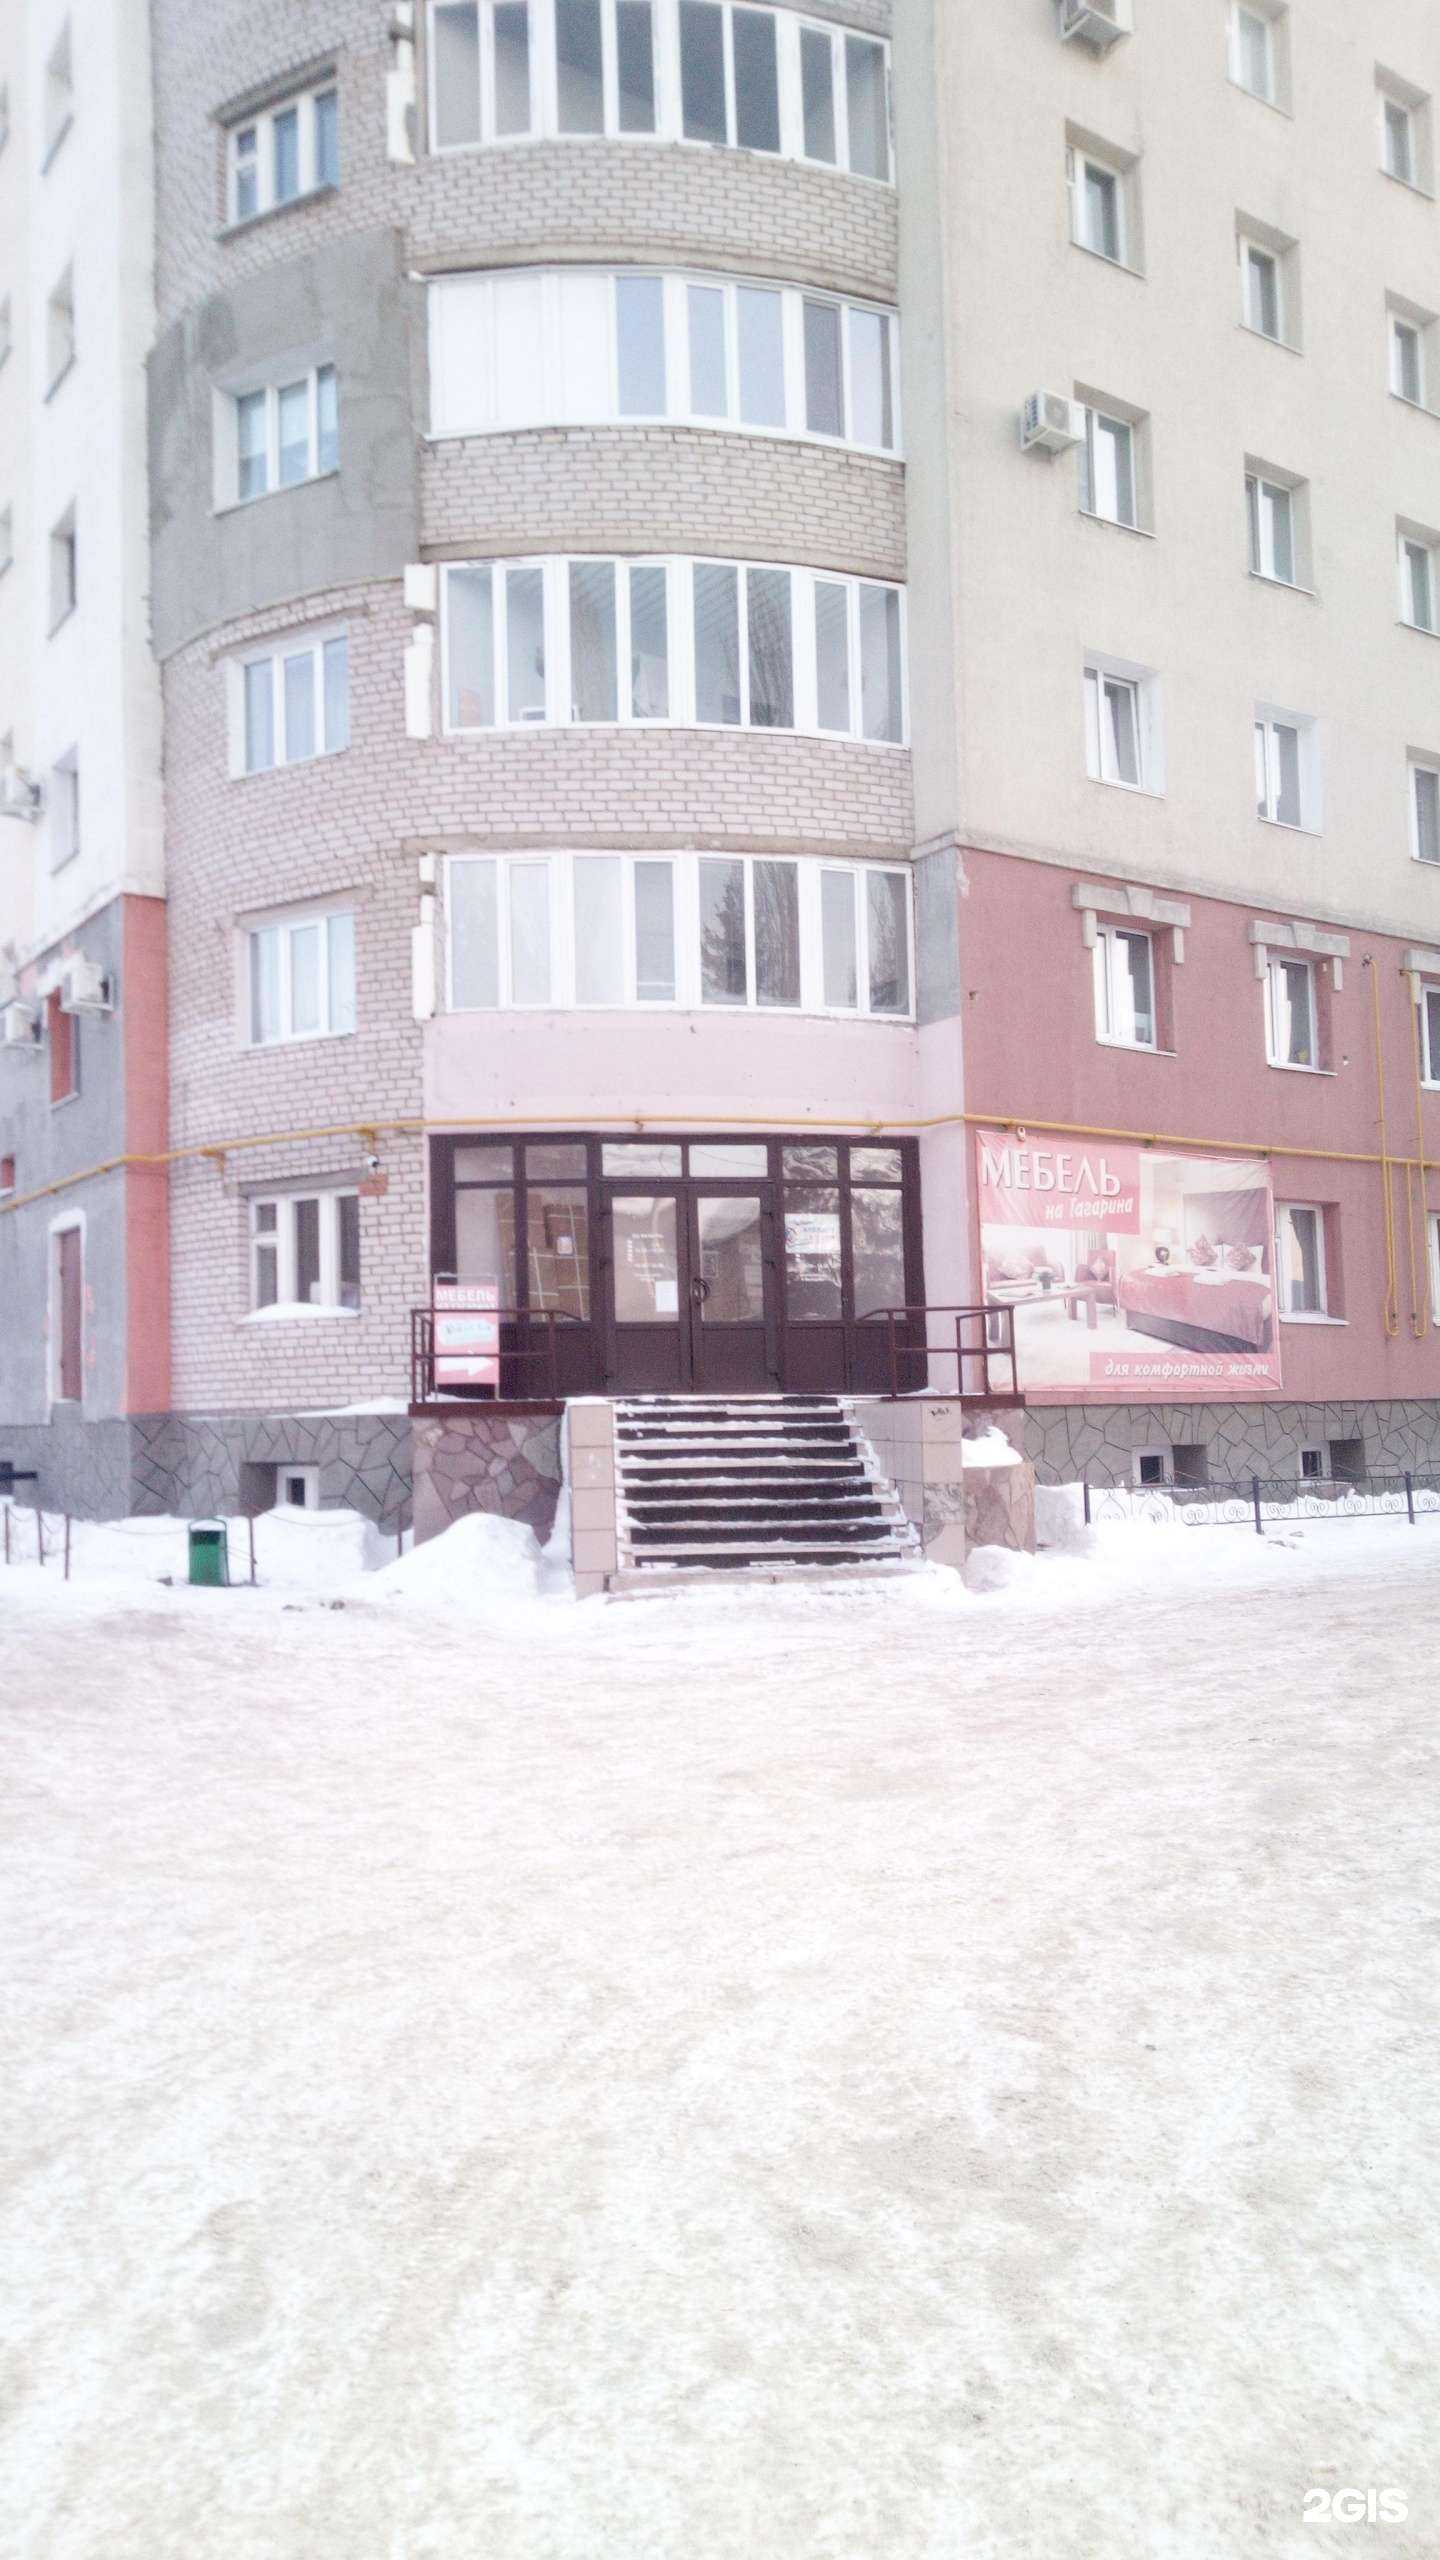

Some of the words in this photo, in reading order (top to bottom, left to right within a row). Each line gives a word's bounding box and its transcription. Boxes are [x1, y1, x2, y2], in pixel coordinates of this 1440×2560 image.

[982, 1146, 1121, 1197] МЕБЕЛЬ
[1045, 1203, 1064, 1220] на
[1070, 1196, 1134, 1219] Гагарина
[436, 1288, 497, 1303] МЕБЕЛЬ
[1104, 1359, 1129, 1376] для
[1134, 1360, 1224, 1381] комфортной
[1227, 1362, 1270, 1377] жизни
